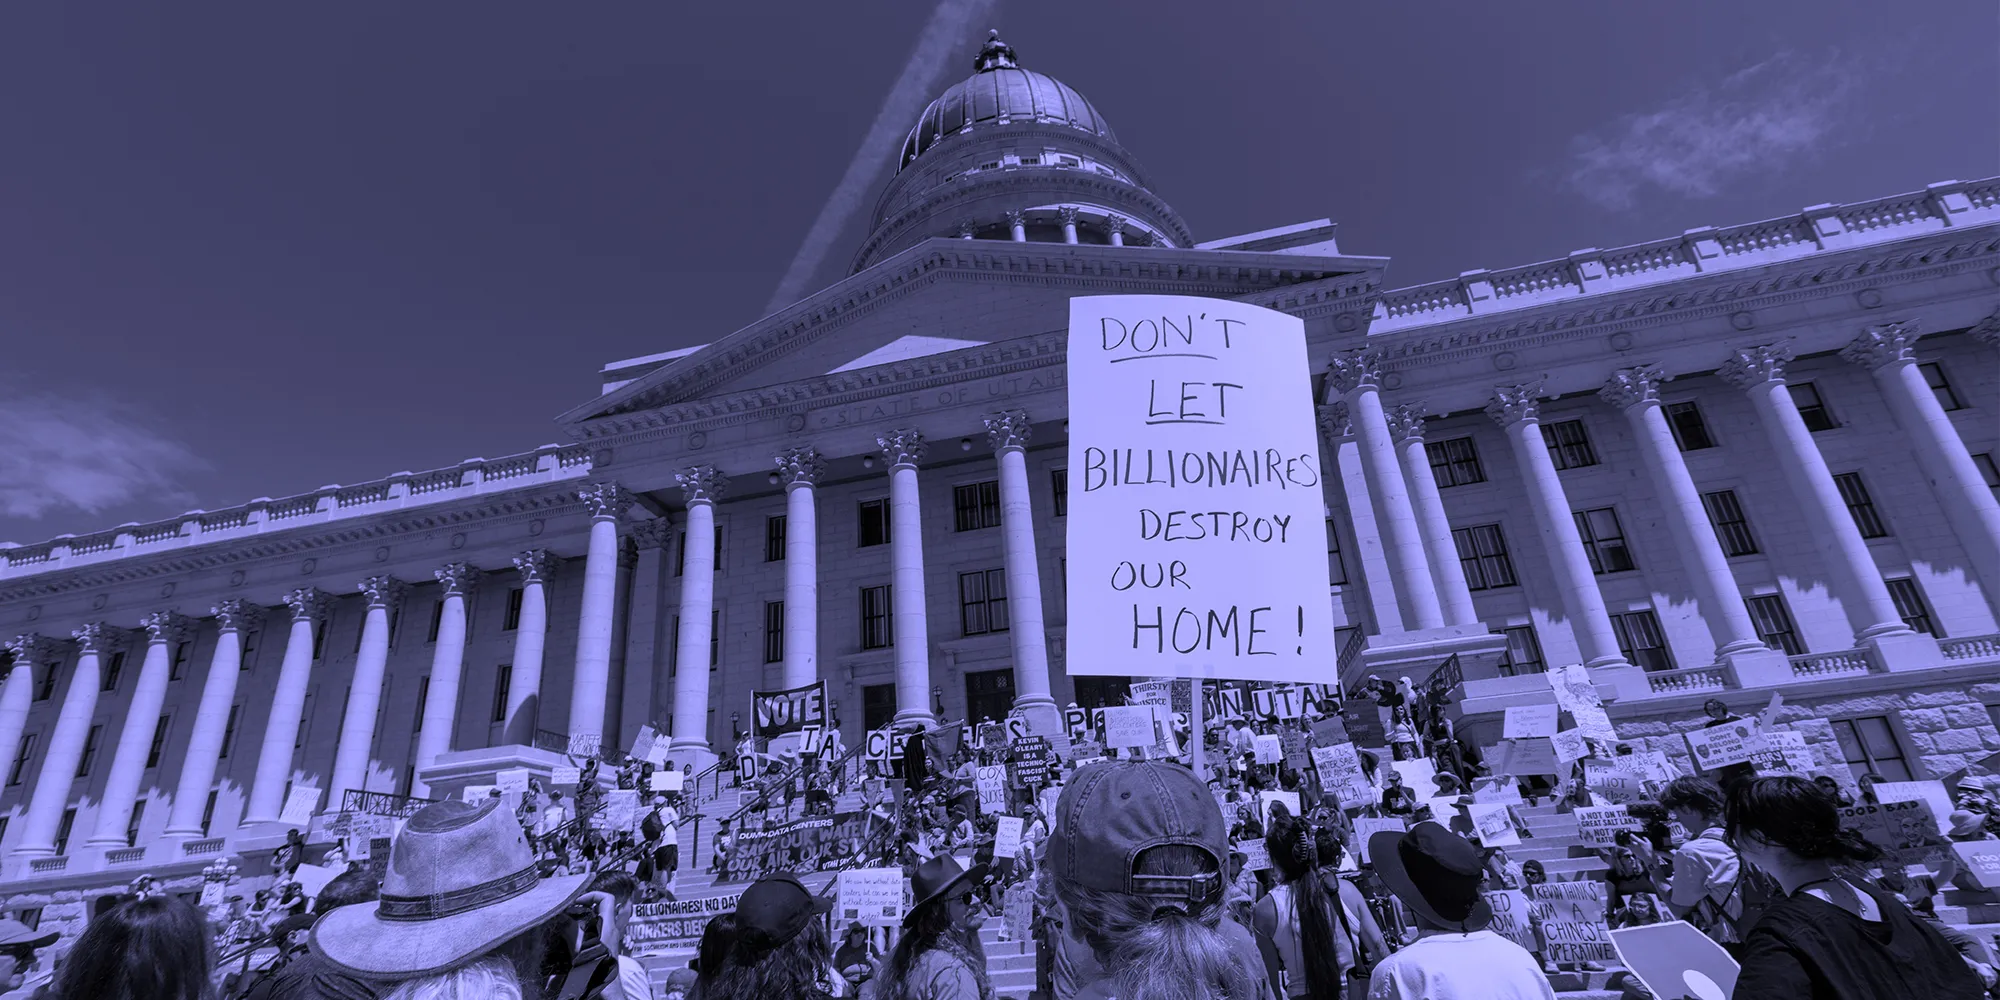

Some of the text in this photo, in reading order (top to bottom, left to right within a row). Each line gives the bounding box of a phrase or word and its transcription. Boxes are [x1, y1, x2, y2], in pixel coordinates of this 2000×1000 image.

[1101, 312, 1246, 352] DON'T
[837, 369, 1067, 425] STATE OF UTAH
[1148, 379, 1243, 418] LET
[1084, 447, 1318, 492] BILLIONAIRES
[1139, 509, 1291, 543] DESTROY
[1111, 560, 1191, 591] OUR
[1133, 682, 1168, 694] THIRSTY
[757, 688, 821, 728] VOTE
[1254, 684, 1343, 719] UTAH
[1015, 744, 1043, 752] O'LEARY
[1708, 738, 1741, 749] BELONG
[1726, 744, 1744, 753] OUR
[978, 766, 1005, 780] COX
[1018, 767, 1046, 775] FASCIST
[1601, 777, 1628, 789] NOT
[1586, 810, 1627, 820] NOT ON TH
[1885, 800, 1920, 812] BAD
[768, 826, 789, 838] DATA
[790, 819, 834, 832] CENTERS
[1581, 820, 1601, 828] GREAT
[1603, 819, 1619, 827] SALT
[1594, 828, 1609, 836] NOT
[727, 857, 762, 872] OUR
[1535, 882, 1598, 901] KEVIN THINKS
[636, 894, 740, 917] BILLIONAIRES! NO DAT
[1572, 903, 1586, 920] A
[626, 919, 709, 941] WORKERS DEC
[1544, 921, 1608, 942] CHINESE
[1548, 943, 1615, 961] OPERATIVE
